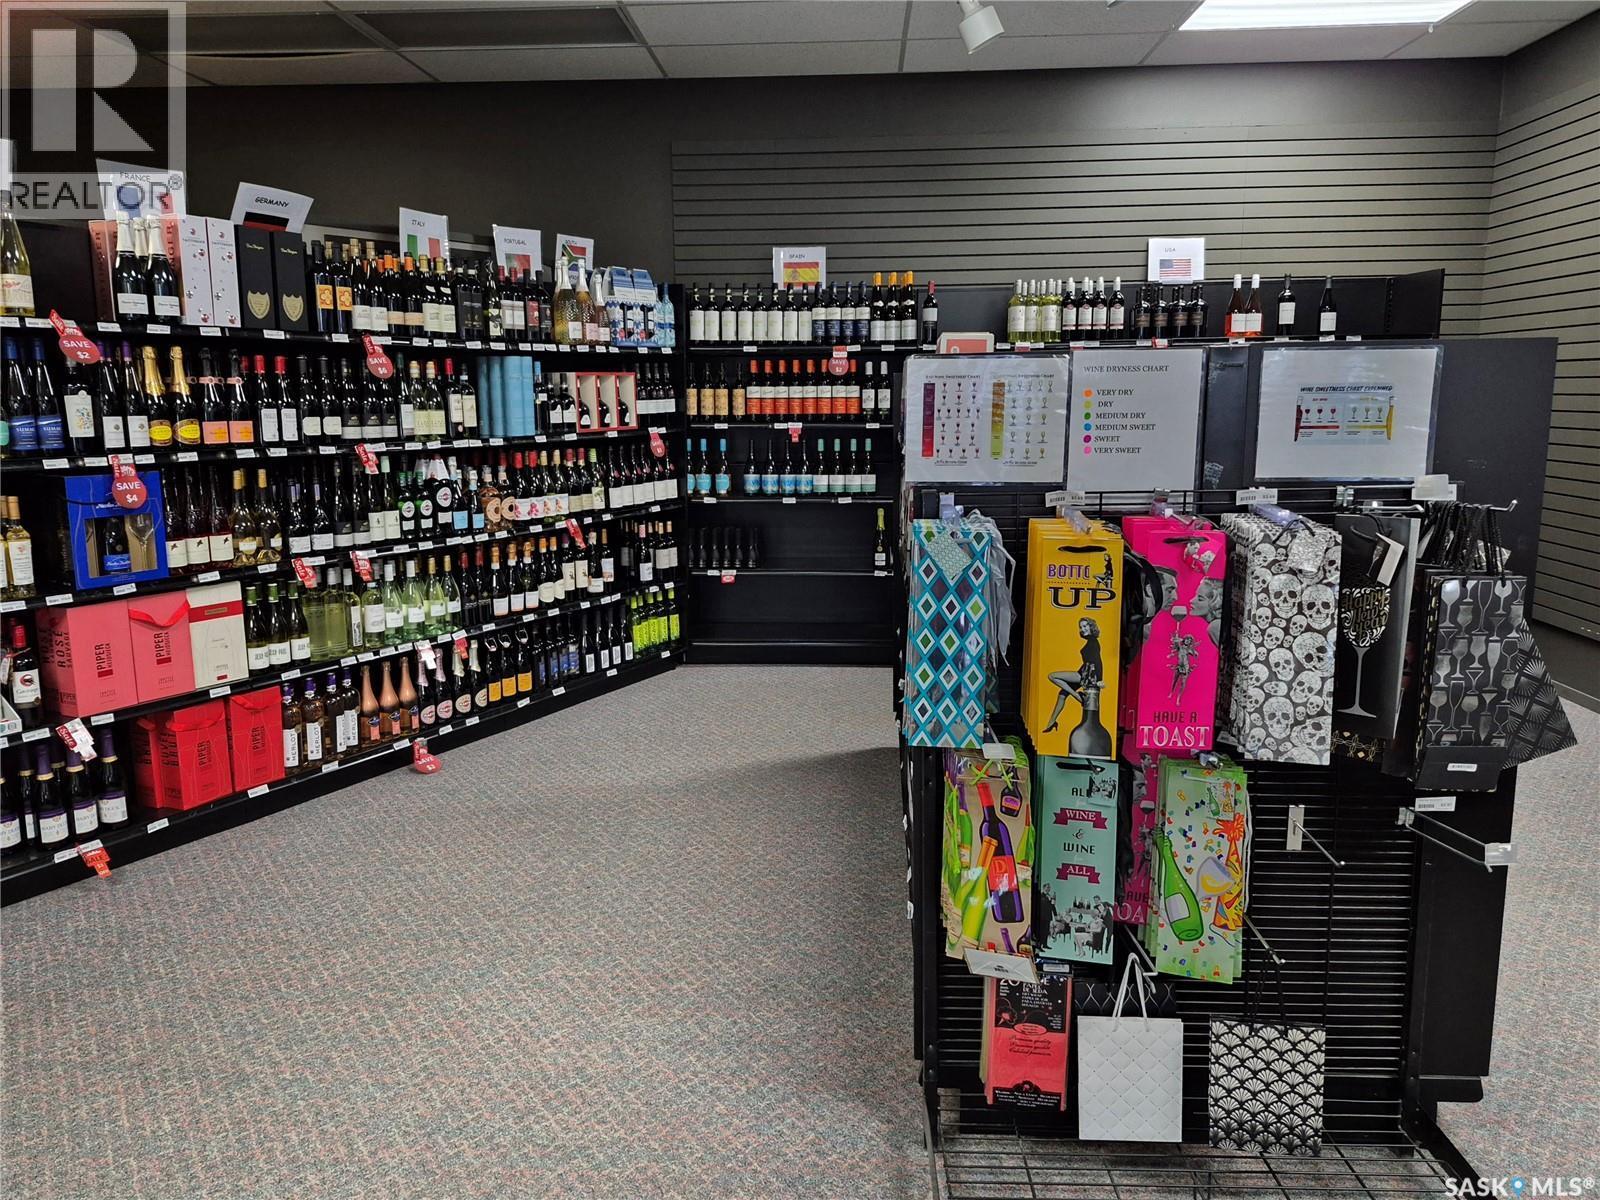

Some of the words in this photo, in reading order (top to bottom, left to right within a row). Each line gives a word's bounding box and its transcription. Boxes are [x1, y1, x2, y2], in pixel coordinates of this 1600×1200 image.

[254, 196, 290, 208] GERMANY
[411, 219, 426, 228] ITALY
[62, 340, 92, 349] SAVE
[76, 350, 91, 359] $2
[1106, 365, 1141, 373] DRYNESS
[1098, 400, 1114, 408] DRY
[1095, 412, 1129, 420] MEDIUM
[115, 482, 142, 491] SAVE
[126, 493, 138, 504] $4
[1048, 586, 1117, 610] UP
[153, 632, 165, 658] PIPER
[94, 643, 106, 671] PIPER
[1153, 711, 1185, 723] HAVE
[1190, 711, 1198, 723] A
[1140, 725, 1210, 748] TOAST
[1066, 809, 1096, 821] WINE
[1072, 828, 1085, 840] &
[1063, 842, 1096, 855] WINE
[1066, 866, 1091, 876] ALL
